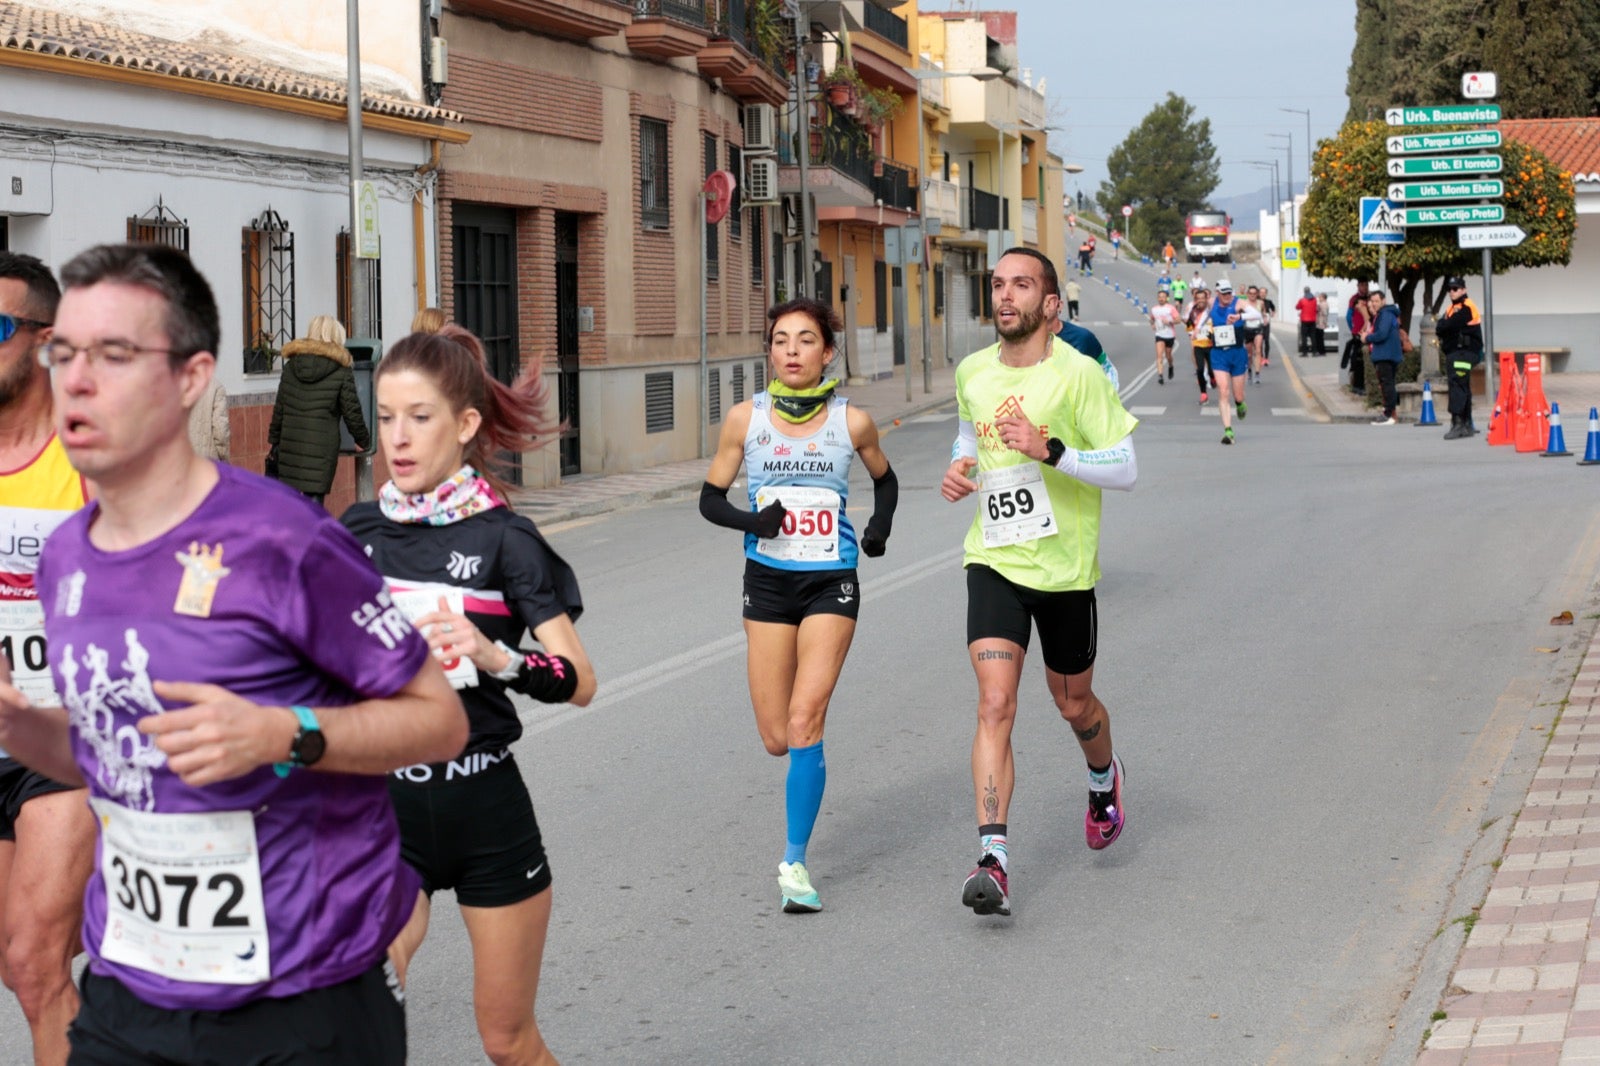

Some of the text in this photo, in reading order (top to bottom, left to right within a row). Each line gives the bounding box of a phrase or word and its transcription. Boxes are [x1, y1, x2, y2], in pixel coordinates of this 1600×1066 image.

[1405, 108, 1498, 122] Urb. Buenavista
[1405, 133, 1497, 148] Urb. Parque del Cubillas
[1431, 160, 1451, 170] Urb.
[1453, 159, 1462, 169] El
[1420, 183, 1498, 196] Urb. Monte Elvira
[1418, 208, 1500, 223] Urb. Cortijo Pretel
[763, 460, 834, 473] MARACENA
[988, 488, 1034, 521] 659
[781, 510, 833, 536] 050
[112, 855, 250, 928] 3072
